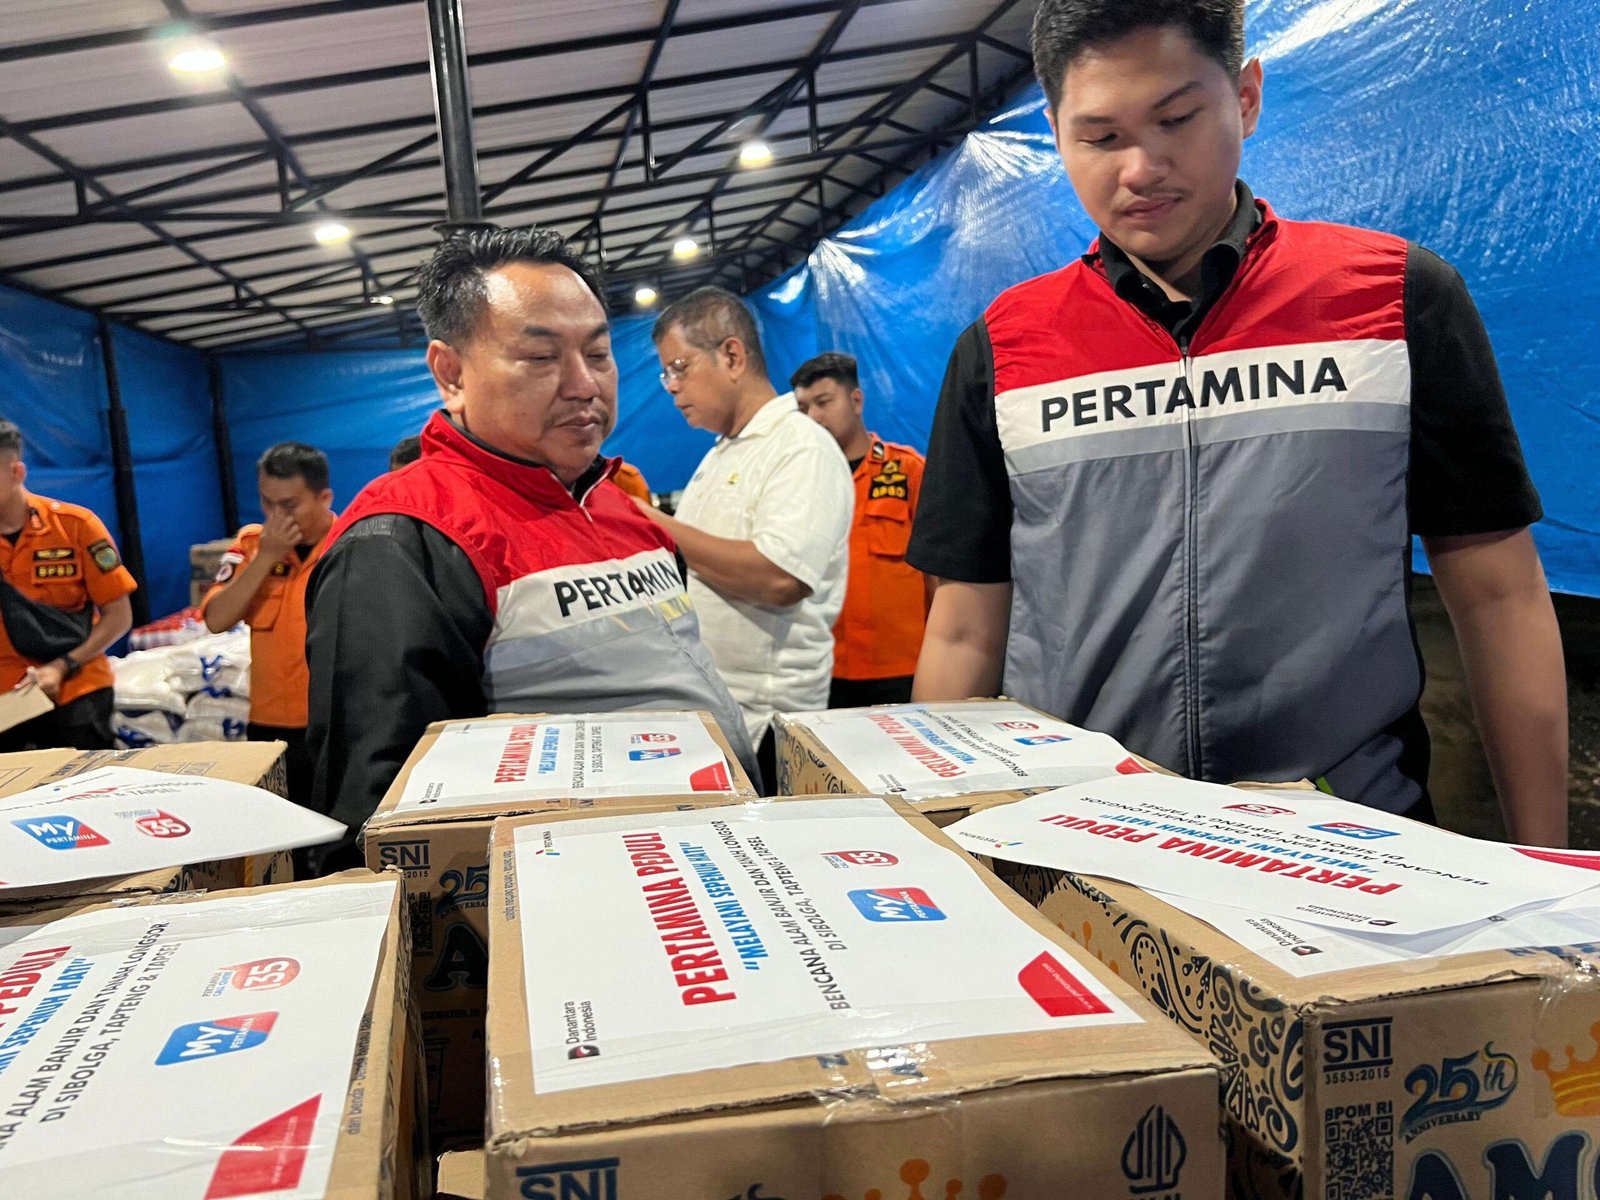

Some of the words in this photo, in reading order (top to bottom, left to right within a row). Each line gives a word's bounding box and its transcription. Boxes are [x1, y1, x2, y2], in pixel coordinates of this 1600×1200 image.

[1042, 357, 1347, 432] PERTAMINA
[893, 736, 966, 777] PERTAMINA
[1080, 798, 1150, 813] LONGSOR
[1140, 803, 1188, 815] TAPSEL
[1152, 813, 1206, 825] TANAH
[45, 833, 97, 844] PERTAMINA
[711, 821, 741, 848] LONGSOR
[1040, 815, 1158, 843] PEDULI
[1209, 818, 1282, 835] TAPTENG
[1210, 825, 1248, 834] DAN
[622, 833, 678, 876] PEDULI
[747, 836, 772, 856] TAPSEL
[1251, 834, 1317, 848] BANJIR
[1293, 834, 1376, 854] SIBOLGA,
[1321, 848, 1378, 860] ALAM
[379, 845, 429, 866] SNI
[730, 850, 758, 867] TANAH
[1158, 837, 1402, 895] PERTAMINA
[692, 863, 734, 897] SEPENUH
[746, 868, 770, 886] DAN
[768, 862, 804, 895] TAPTENG
[1383, 860, 1490, 886] BENCANA
[759, 888, 792, 917] BANJIR
[794, 897, 838, 939] SIBOLGA,
[1260, 917, 1306, 944] Indonesia
[638, 876, 736, 1006] PERTAMINA
[714, 900, 768, 970] "MELAYANI
[780, 920, 812, 945] ALAM
[827, 939, 848, 951] DI
[1245, 918, 1292, 947] Danantara
[143, 943, 181, 972] TAPSEL
[800, 948, 850, 1010] BENCANA
[3, 994, 72, 1049] SEPENUH
[6, 1076, 54, 1116] ALAM
[37, 1026, 90, 1072] BANJIR
[74, 998, 110, 1024] DAN
[95, 964, 137, 997] TANAH
[124, 923, 169, 964] LONGSOR
[99, 985, 150, 1035] TAPTENG
[563, 1001, 580, 1045] Danantara
[577, 1000, 597, 1042] Indonesia
[1323, 1025, 1391, 1064] SNI
[54, 1038, 120, 1102] SIBOLGA,
[1325, 1067, 1390, 1085] 3553:2015
[40, 1106, 70, 1122] DI
[349, 1087, 365, 1116] benda
[1325, 1103, 1371, 1121] BPOM
[1376, 1101, 1393, 1116] RI
[347, 1117, 361, 1135] dan
[1404, 1111, 1484, 1144] ANNIVERSARY
